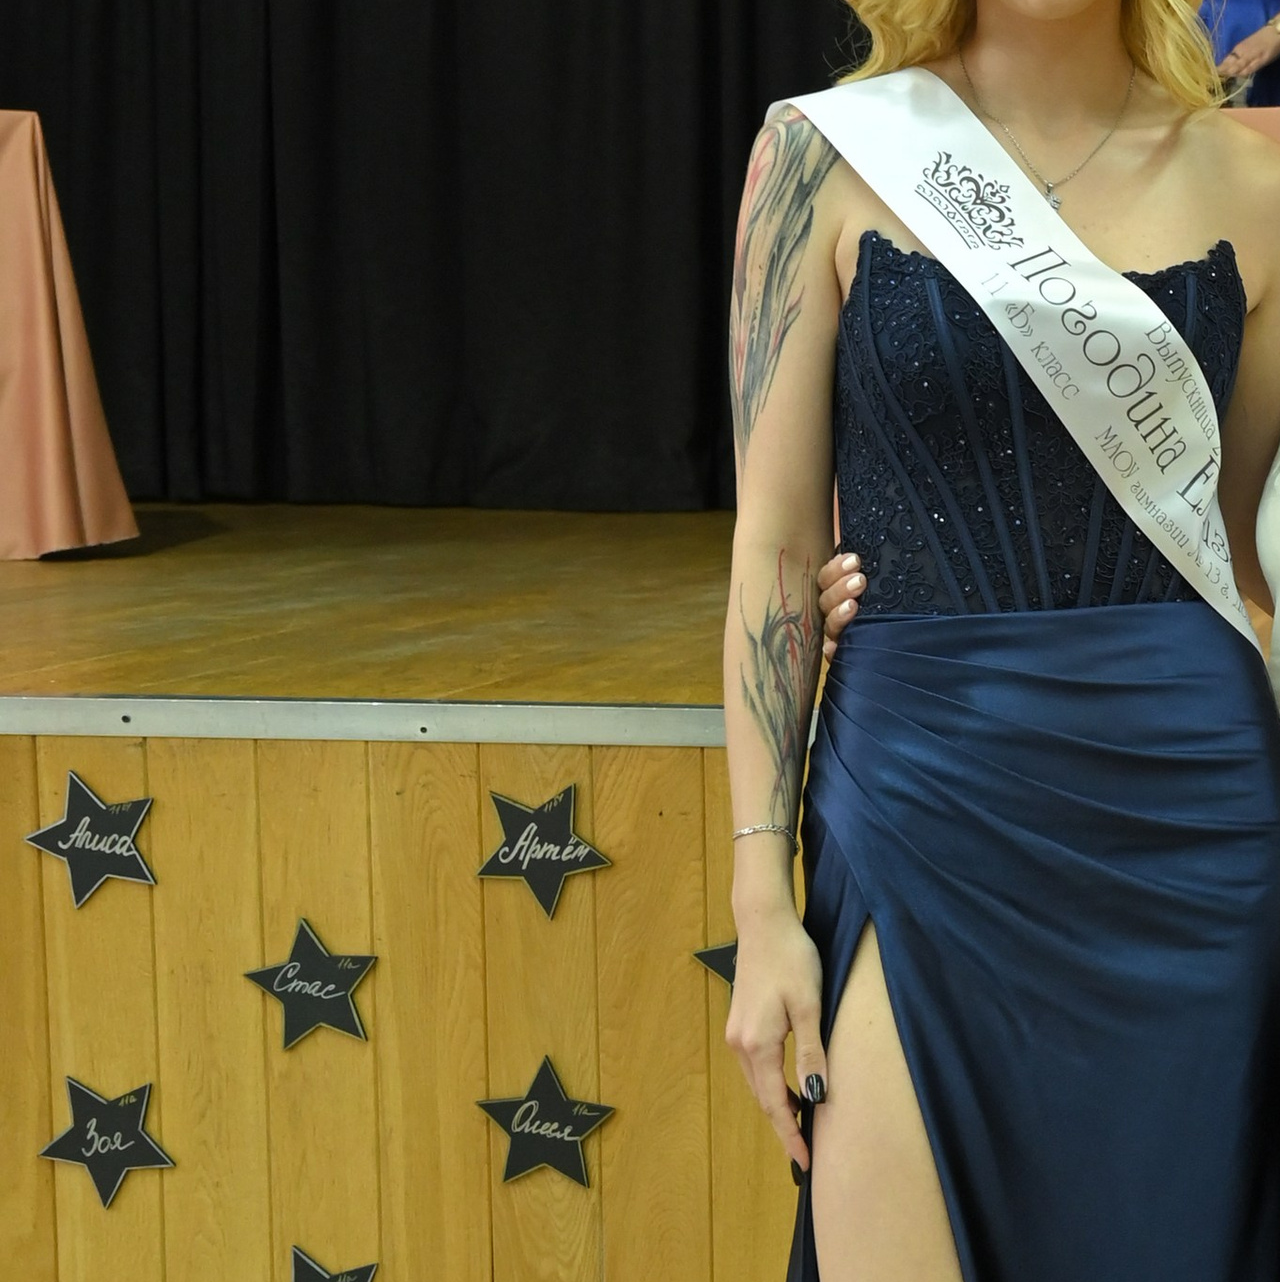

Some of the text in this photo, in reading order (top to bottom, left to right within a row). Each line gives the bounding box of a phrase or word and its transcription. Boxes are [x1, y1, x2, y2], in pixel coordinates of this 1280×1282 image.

[1006, 245, 1187, 475] Погодина
[1144, 319, 1217, 441] Выпускница
[1030, 341, 1080, 400] класс
[1129, 480, 1190, 550] гимназии
[1204, 561, 1221, 585] 13
[58, 816, 137, 857] Алиса
[499, 822, 592, 867] Артём
[273, 962, 347, 999] Стас
[81, 1118, 135, 1157] Зоя
